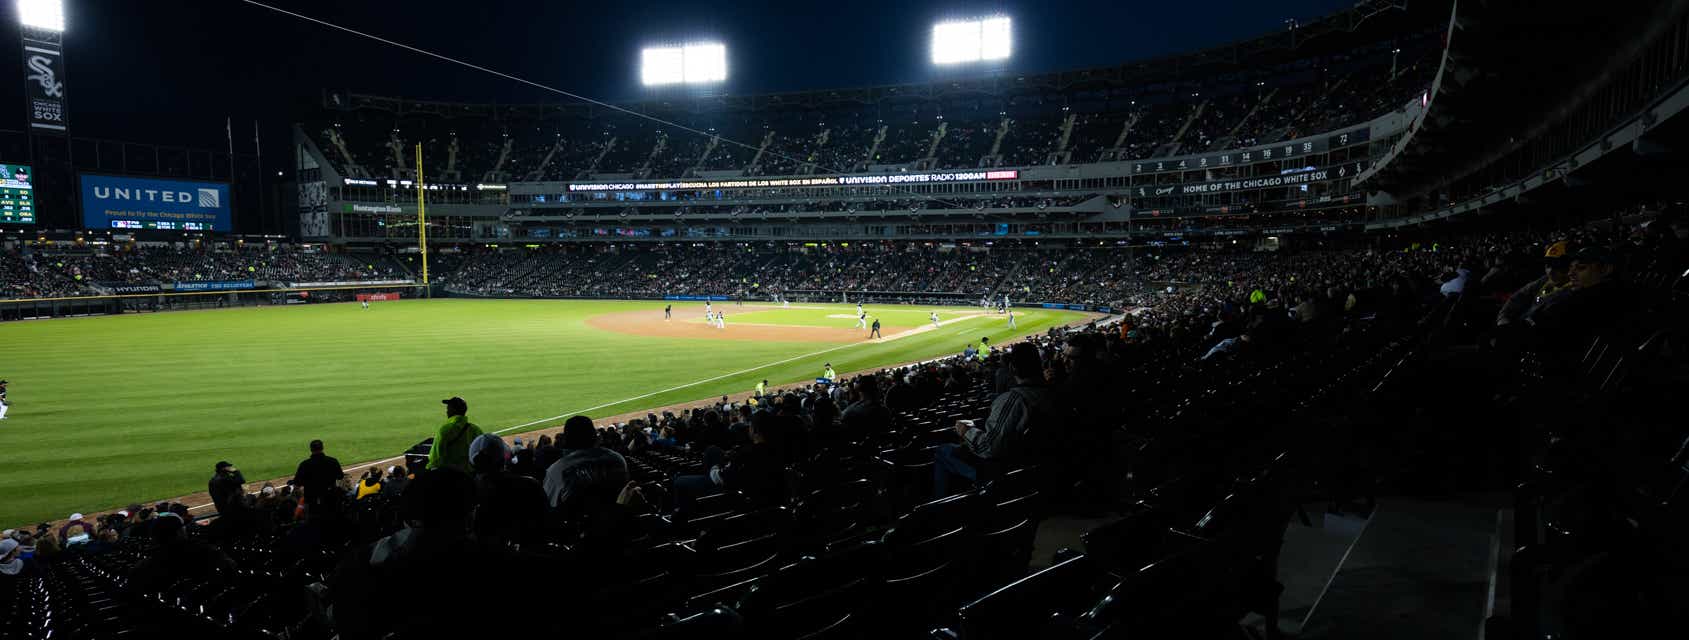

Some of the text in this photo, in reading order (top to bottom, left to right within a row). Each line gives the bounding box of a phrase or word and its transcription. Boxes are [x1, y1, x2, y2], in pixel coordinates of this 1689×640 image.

[34, 111, 62, 121] SOX
[1221, 155, 1229, 163] 11
[1242, 152, 1250, 160] 14
[1263, 149, 1271, 157] 16
[1303, 142, 1312, 151] 35
[1340, 134, 1348, 143] 72
[811, 177, 839, 185] ESPAÑOL
[888, 174, 930, 183] DEPORTES
[931, 173, 955, 182] RADIO
[955, 172, 986, 181] 1200AM
[1183, 184, 1208, 193] HOME
[1210, 183, 1222, 191] OF
[1224, 181, 1241, 190] THE
[1242, 178, 1282, 188] CHICAGO
[1284, 173, 1309, 184] WHITE
[1310, 170, 1328, 181] SOX
[94, 186, 193, 203] UNITED
[160, 211, 185, 219] Chicago
[116, 285, 159, 293] HYUNDAI
